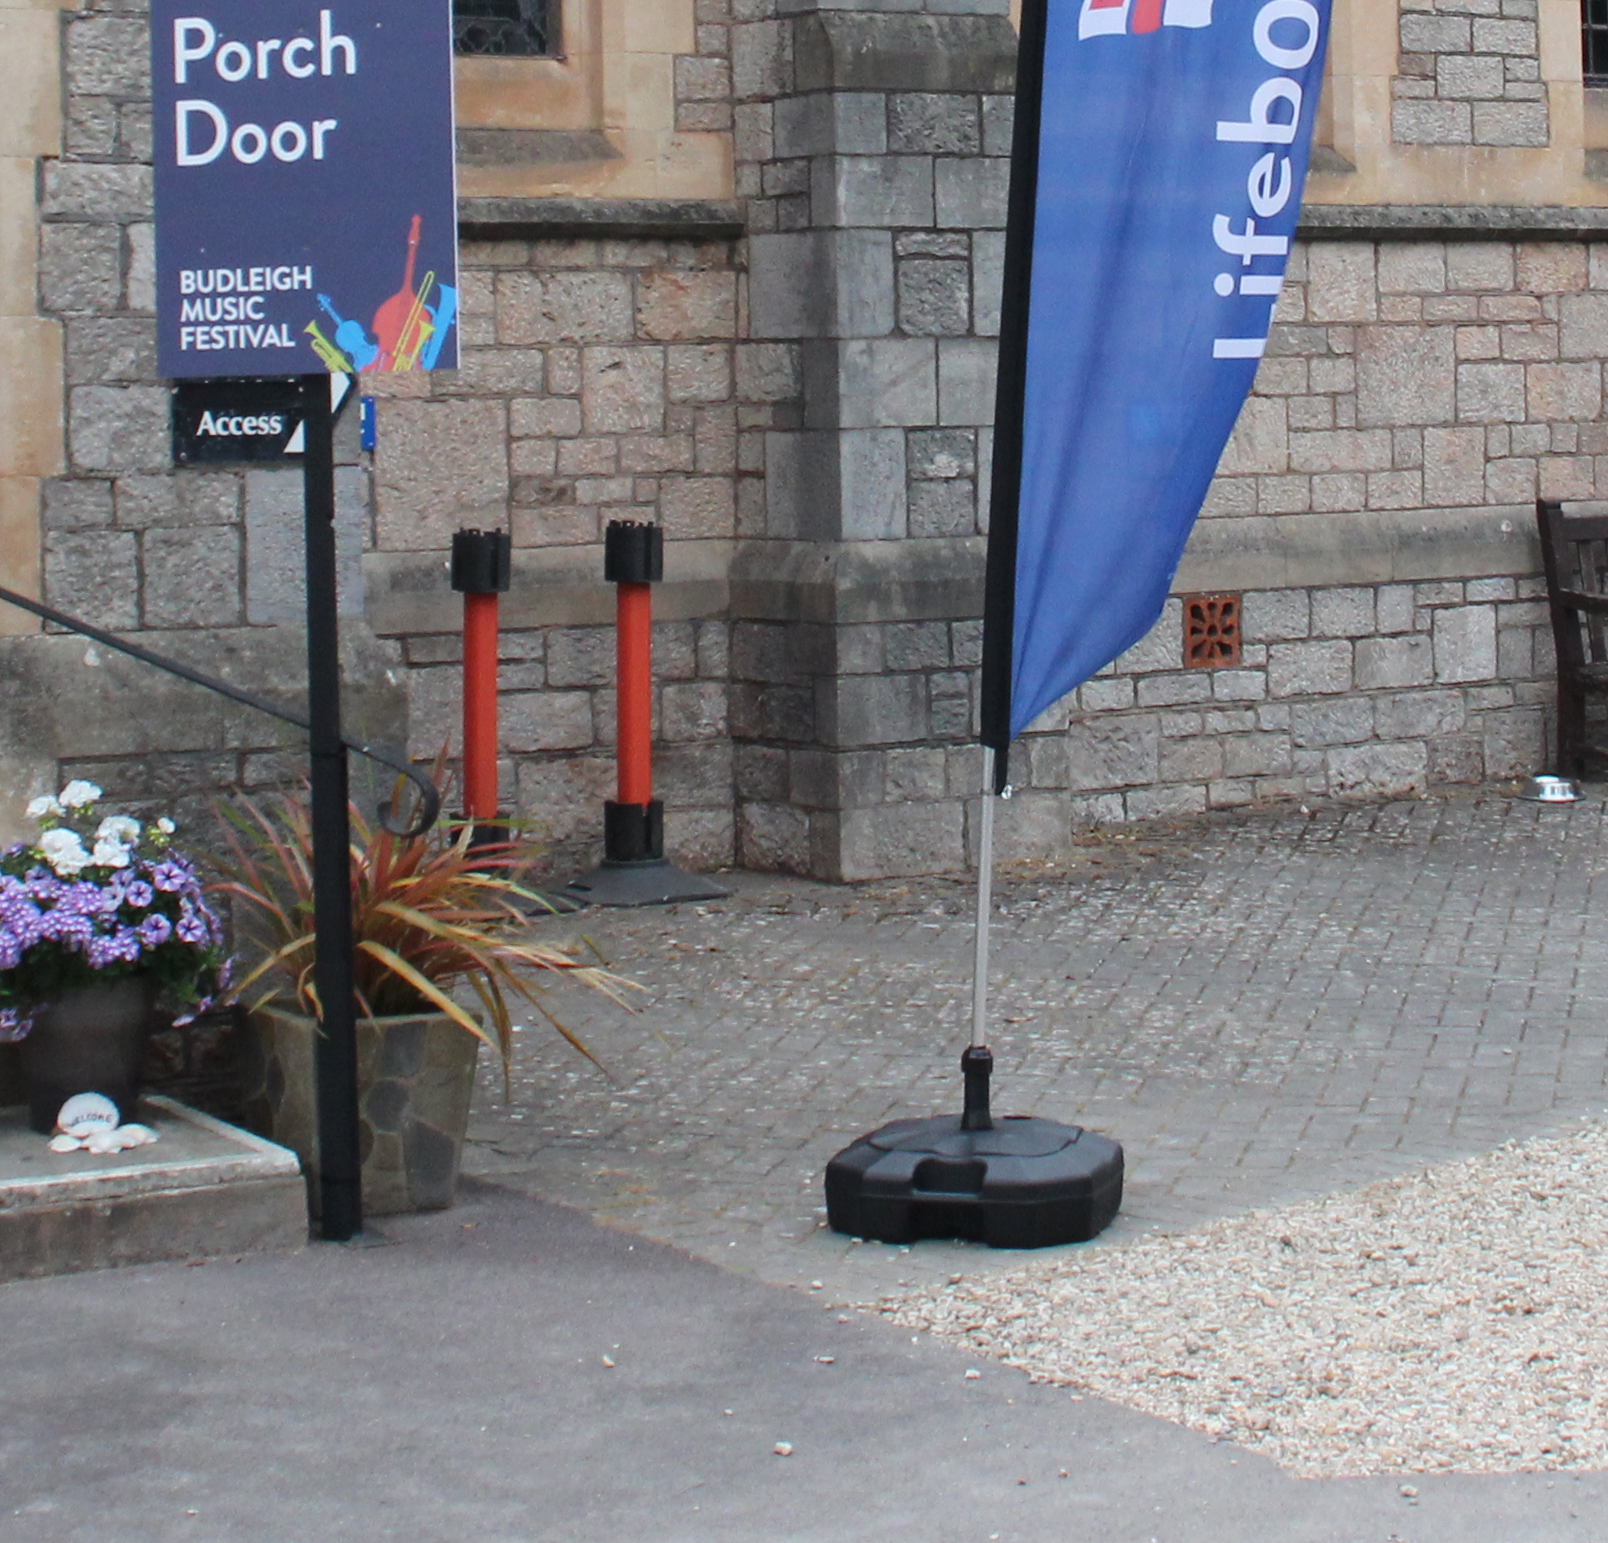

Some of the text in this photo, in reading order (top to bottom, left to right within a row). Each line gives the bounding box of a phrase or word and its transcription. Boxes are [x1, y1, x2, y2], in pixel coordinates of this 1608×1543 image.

[173, 10, 357, 84] Porch
[175, 99, 337, 167] Door
[179, 265, 312, 295] BUDLEIGH
[180, 295, 265, 322] MUSIC
[180, 323, 295, 351] FESTIVAL
[196, 411, 282, 437] Access
